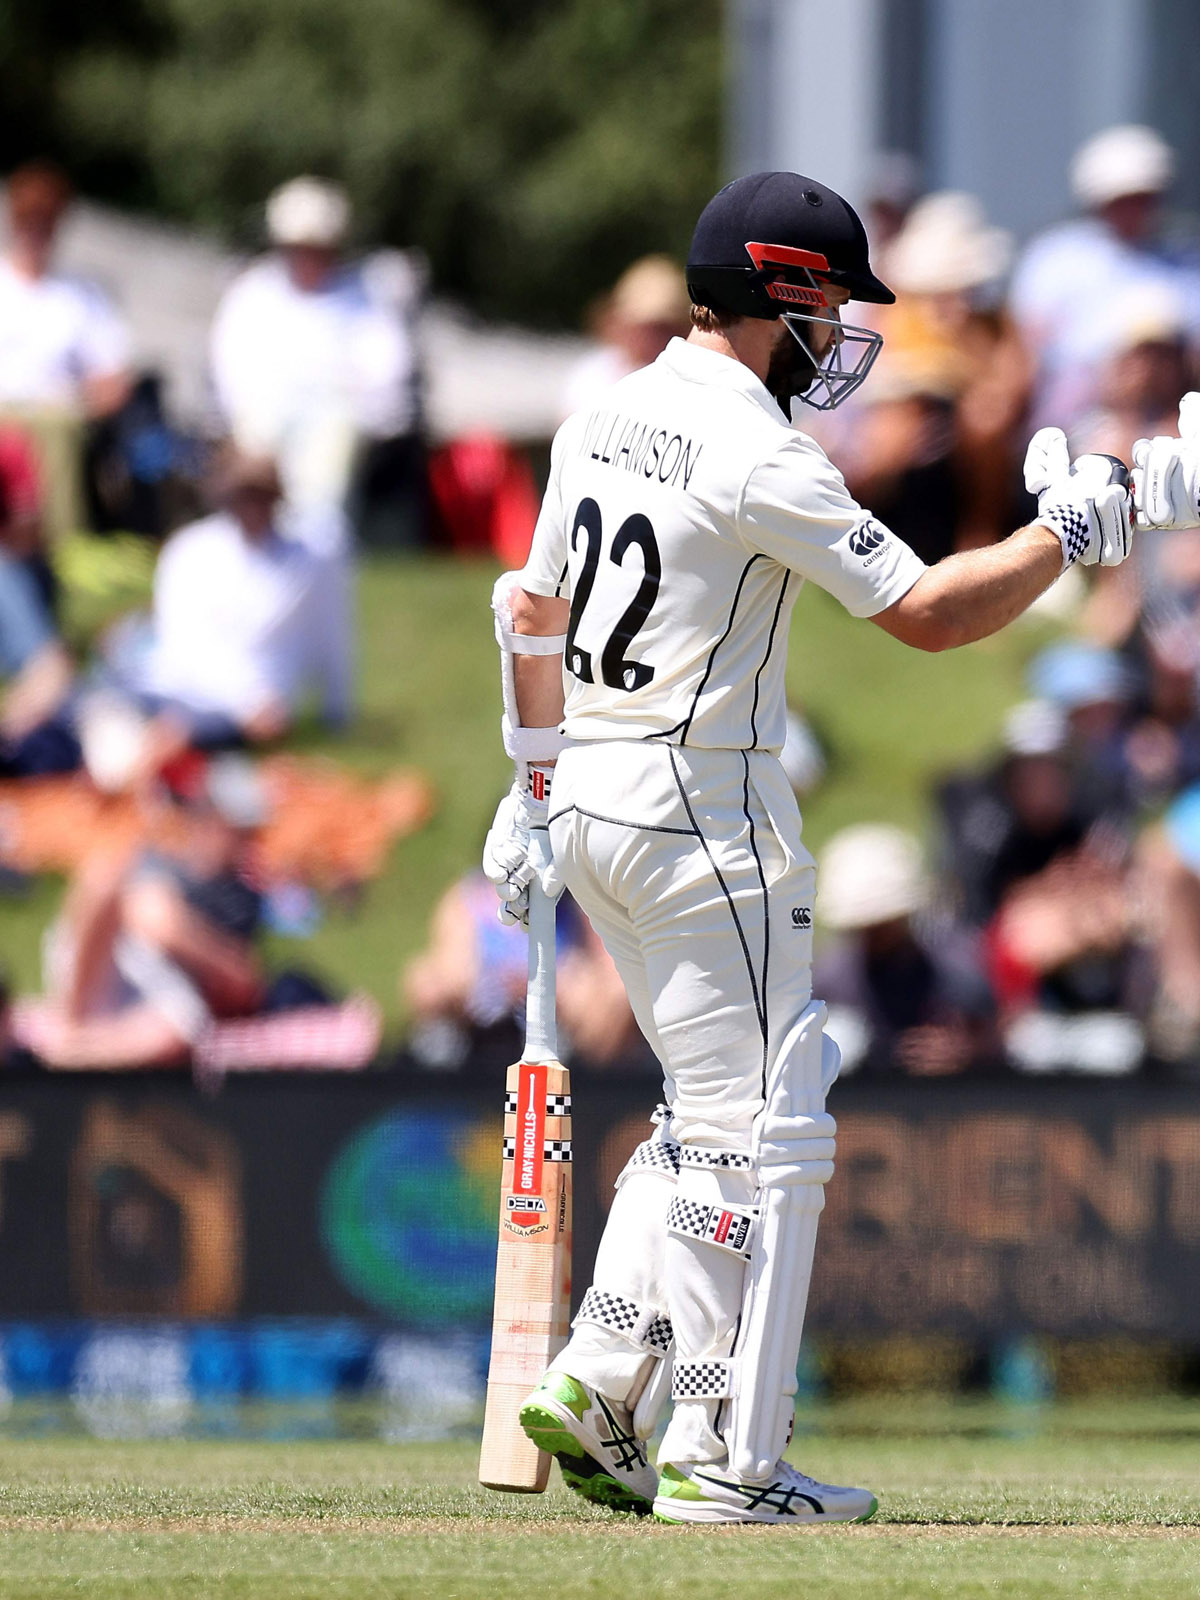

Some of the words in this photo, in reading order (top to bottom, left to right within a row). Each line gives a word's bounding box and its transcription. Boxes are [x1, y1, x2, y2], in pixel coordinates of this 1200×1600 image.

[565, 497, 661, 693] 22
[506, 1196, 548, 1212] DELTA
[734, 1223, 749, 1247] SILVER
